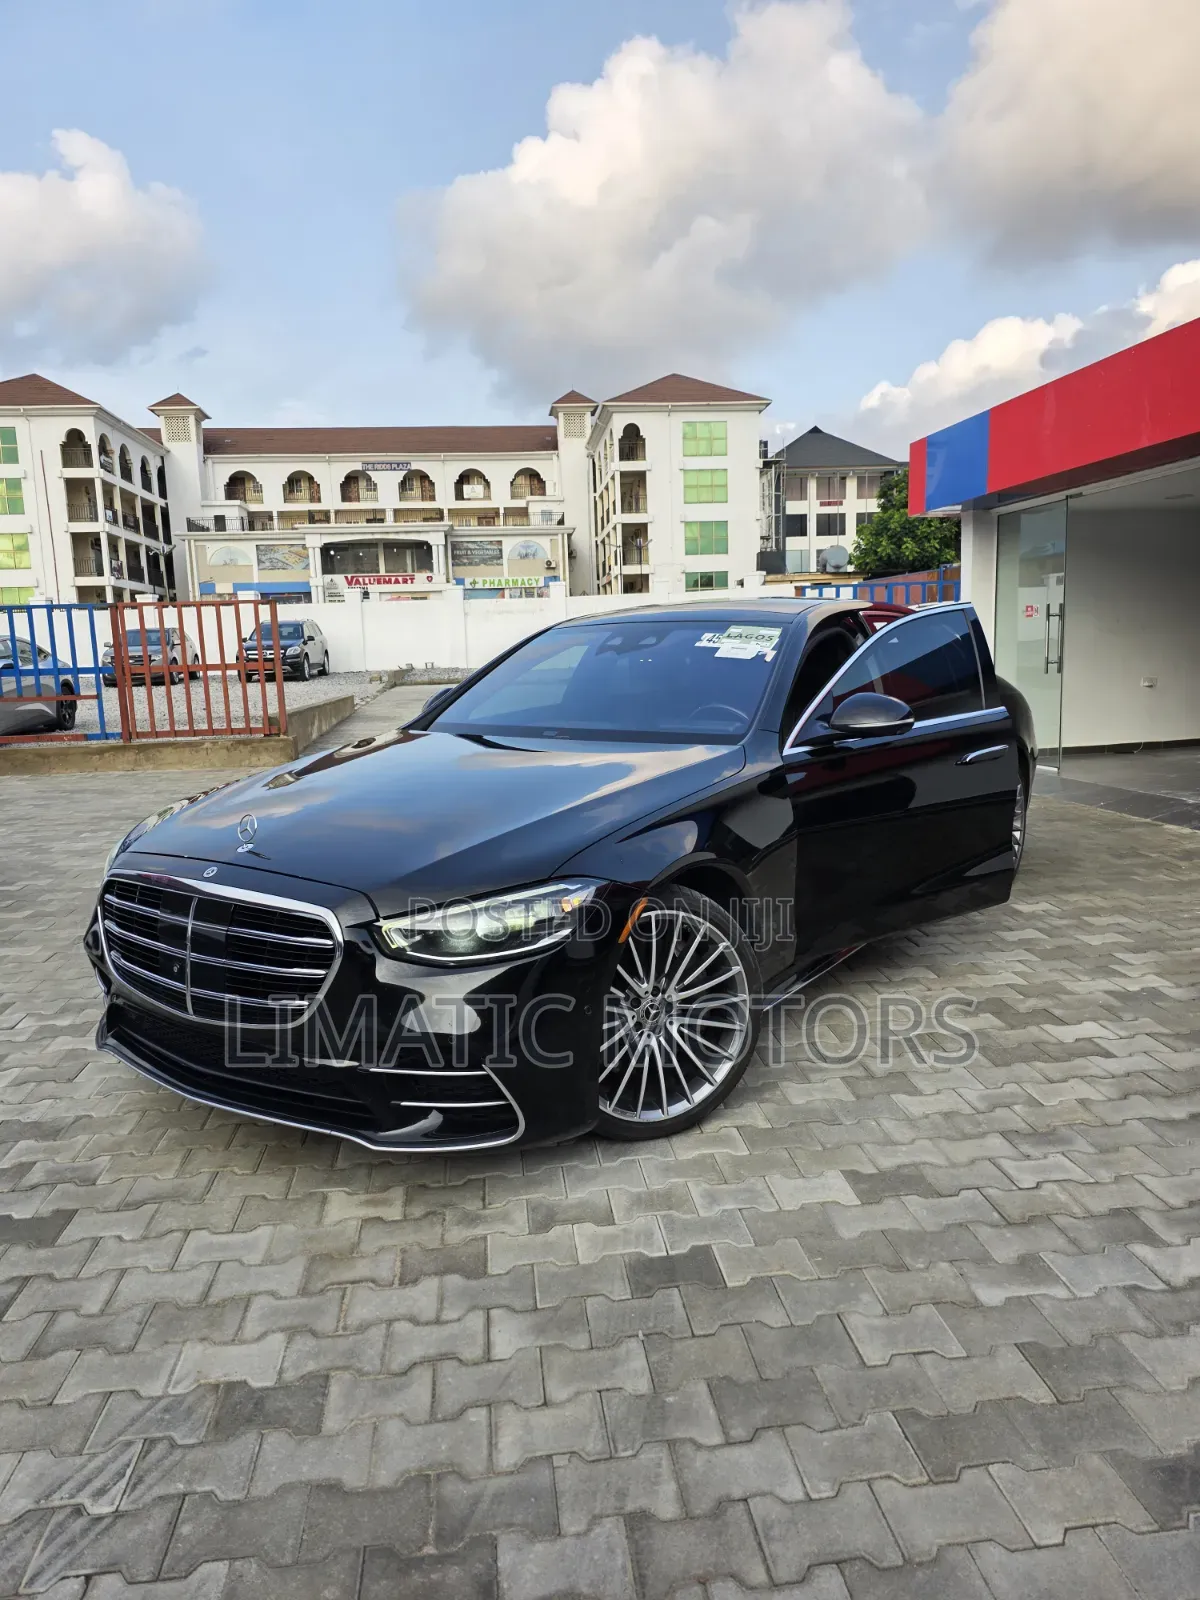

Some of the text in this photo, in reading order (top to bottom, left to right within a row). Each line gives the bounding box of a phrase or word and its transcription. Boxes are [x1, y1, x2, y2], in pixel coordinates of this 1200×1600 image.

[362, 463, 374, 471] THE
[392, 463, 411, 471] PLAZA
[482, 578, 540, 587] PHARMACY
[727, 633, 775, 642] LAGOS
